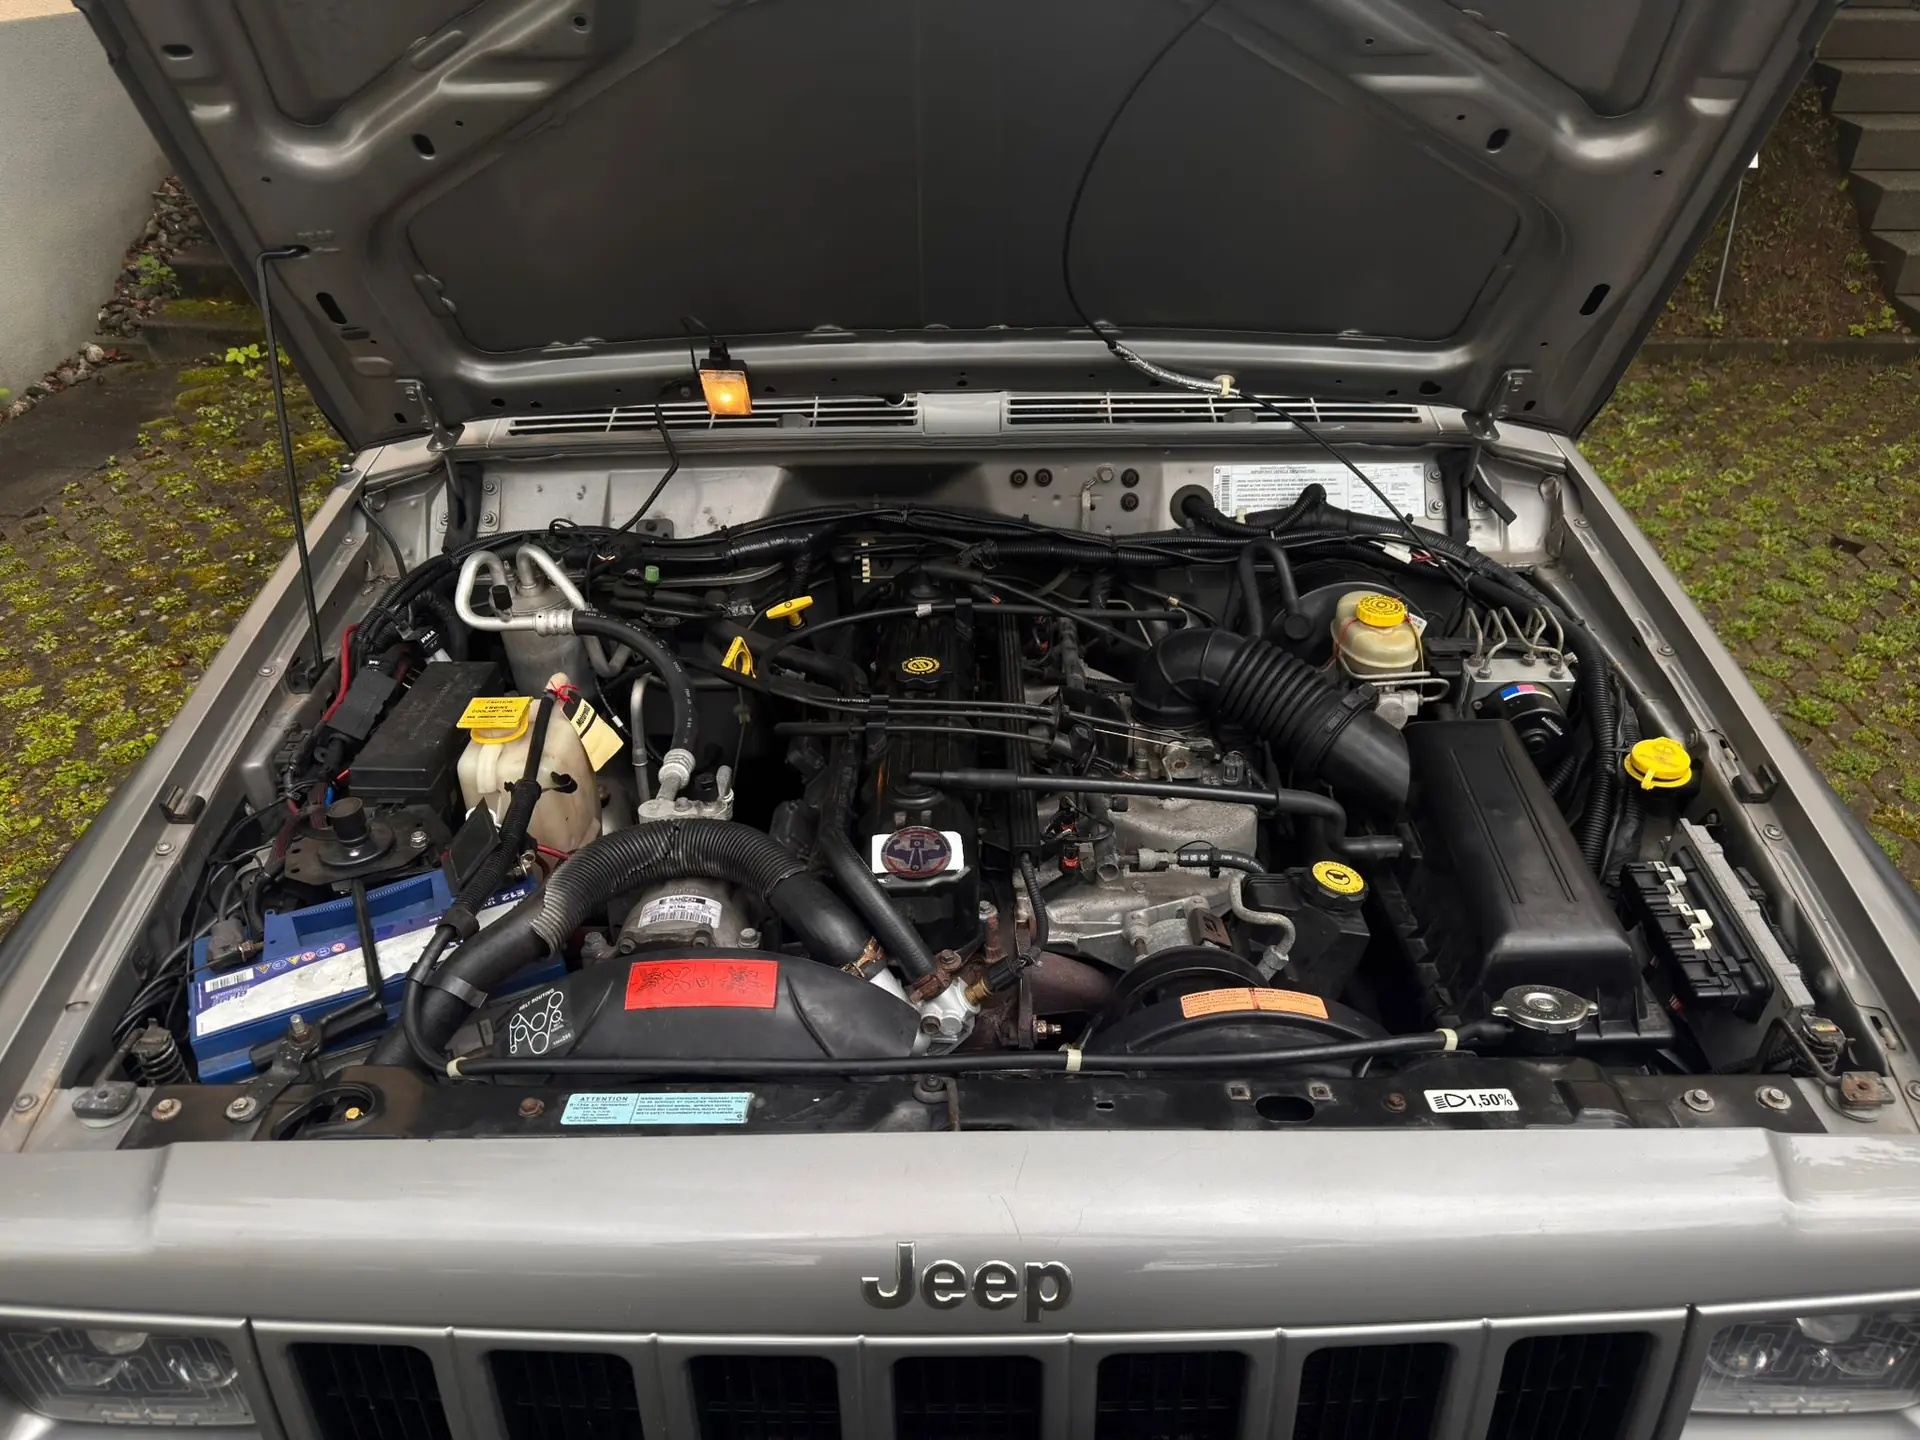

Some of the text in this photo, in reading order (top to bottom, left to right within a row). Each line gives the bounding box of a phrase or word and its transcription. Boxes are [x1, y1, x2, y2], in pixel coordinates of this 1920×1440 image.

[421, 630, 435, 643] PIAA
[1466, 1093, 1513, 1108] 1,50%
[861, 1241, 1073, 1322] Jeep
